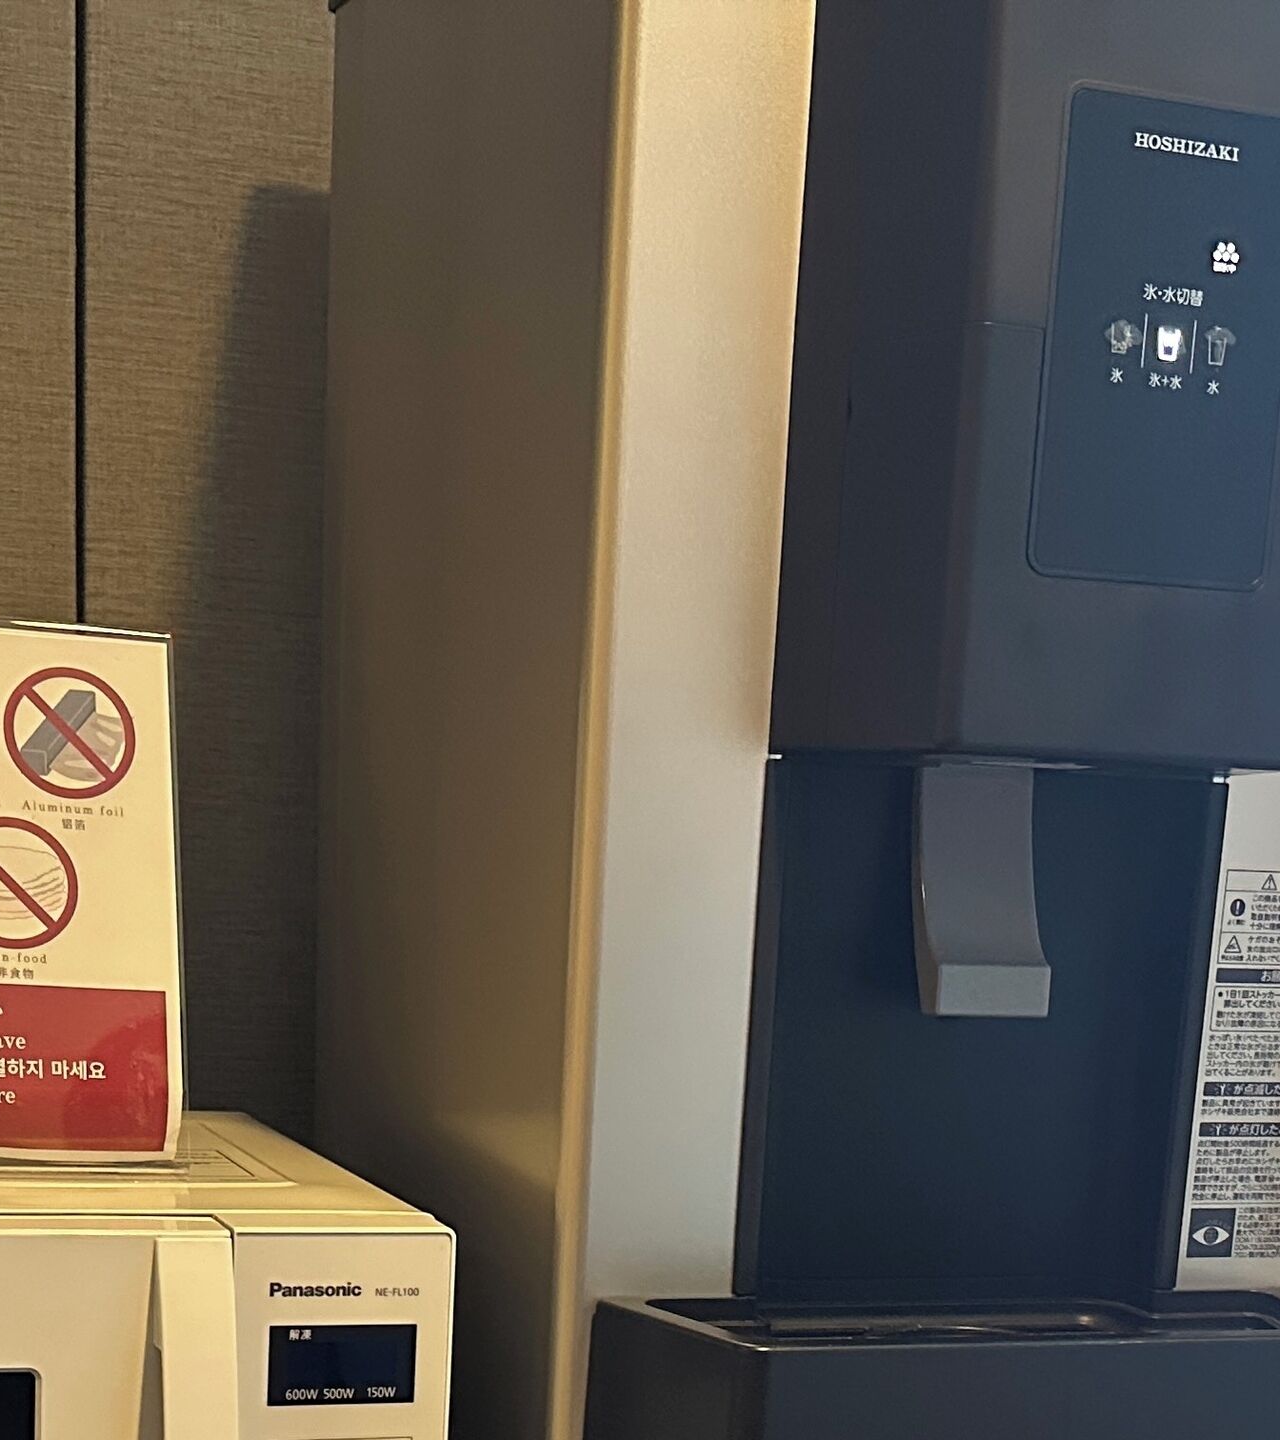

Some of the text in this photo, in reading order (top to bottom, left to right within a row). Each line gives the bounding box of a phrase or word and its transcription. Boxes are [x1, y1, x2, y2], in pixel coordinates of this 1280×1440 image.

[1135, 132, 1239, 162] HOSHIZAKI
[22, 800, 124, 818] Aluminum foil
[52, 1060, 106, 1080] 마세요
[270, 1282, 419, 1297] Panasonic NE-FL100
[289, 1330, 312, 1340] 解凍
[286, 1387, 396, 1400] 600W 500W 150W
